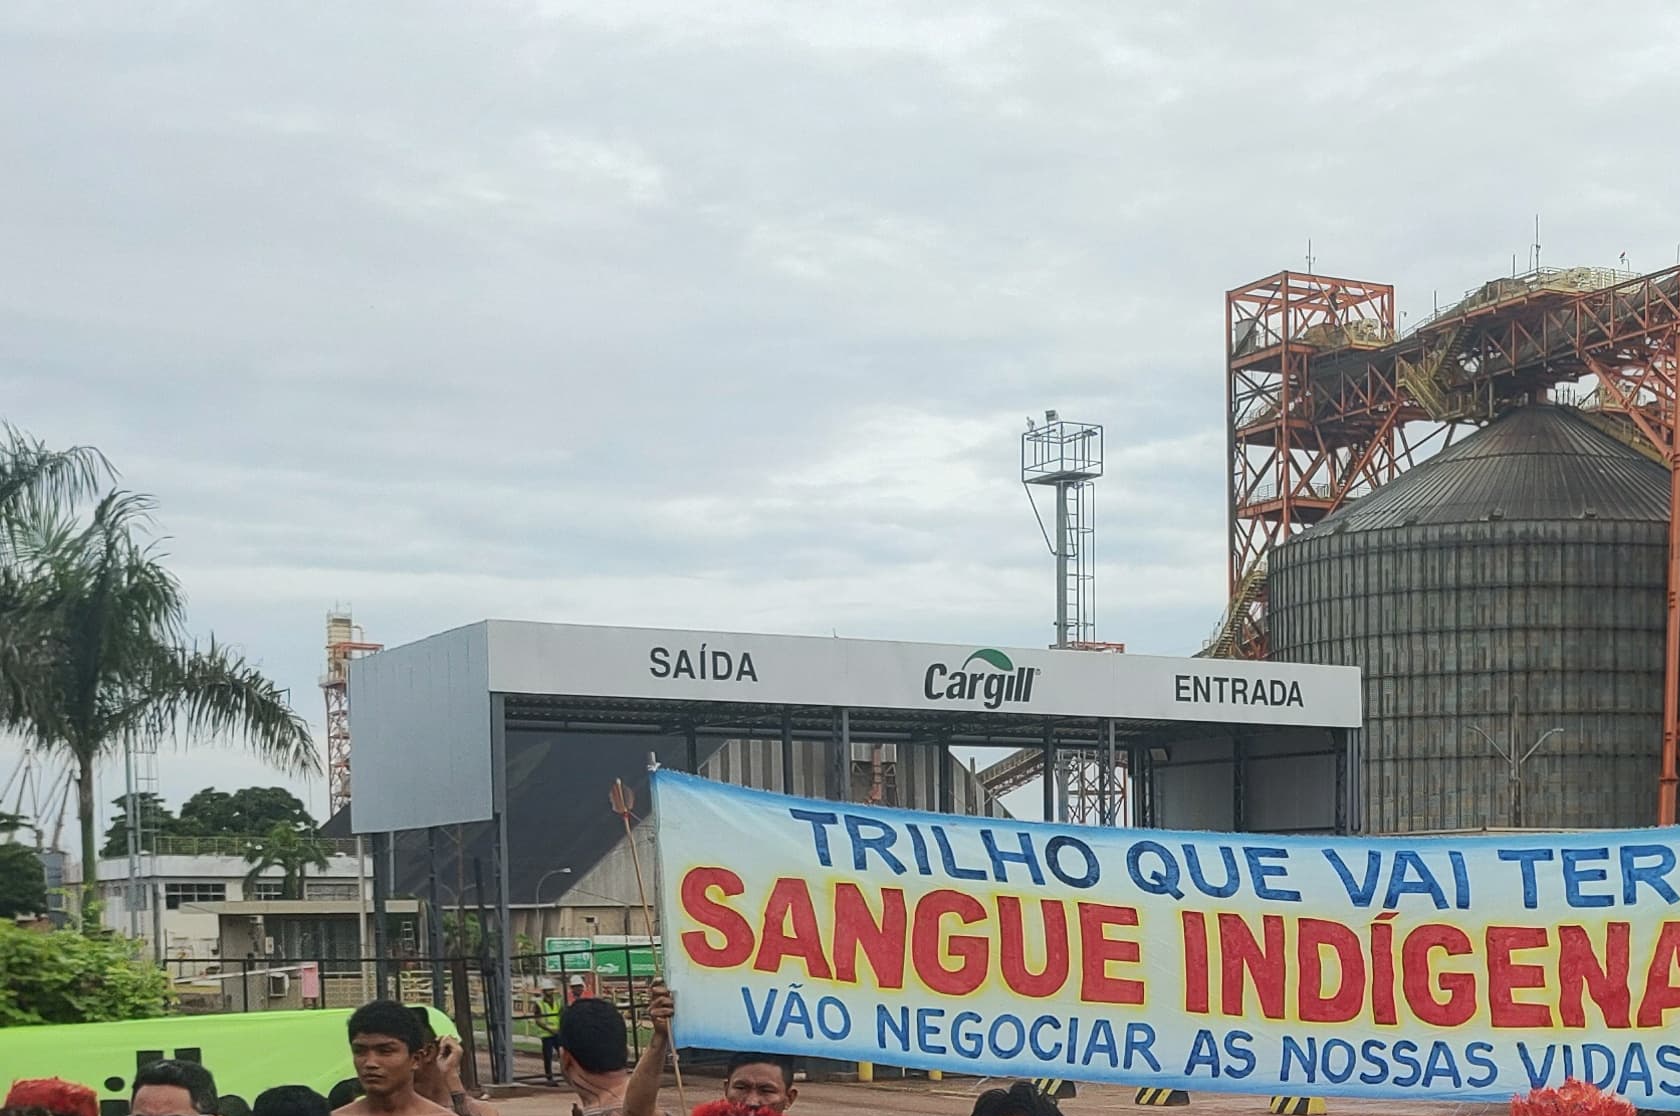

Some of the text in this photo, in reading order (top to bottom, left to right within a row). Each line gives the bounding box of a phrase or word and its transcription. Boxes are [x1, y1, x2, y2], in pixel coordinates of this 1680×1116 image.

[649, 643, 758, 682] SAÍDA
[924, 663, 1035, 709] Cargill
[1175, 675, 1304, 707] ENTRADA
[789, 808, 1680, 911] TRILHO QUE VAI TER
[681, 866, 1146, 1006] SANGUE
[741, 983, 851, 1041] VÃO
[876, 1003, 1162, 1073] NEGOCIAR
[1183, 1029, 1257, 1080] AS
[1280, 1035, 1499, 1088] NOSSAS
